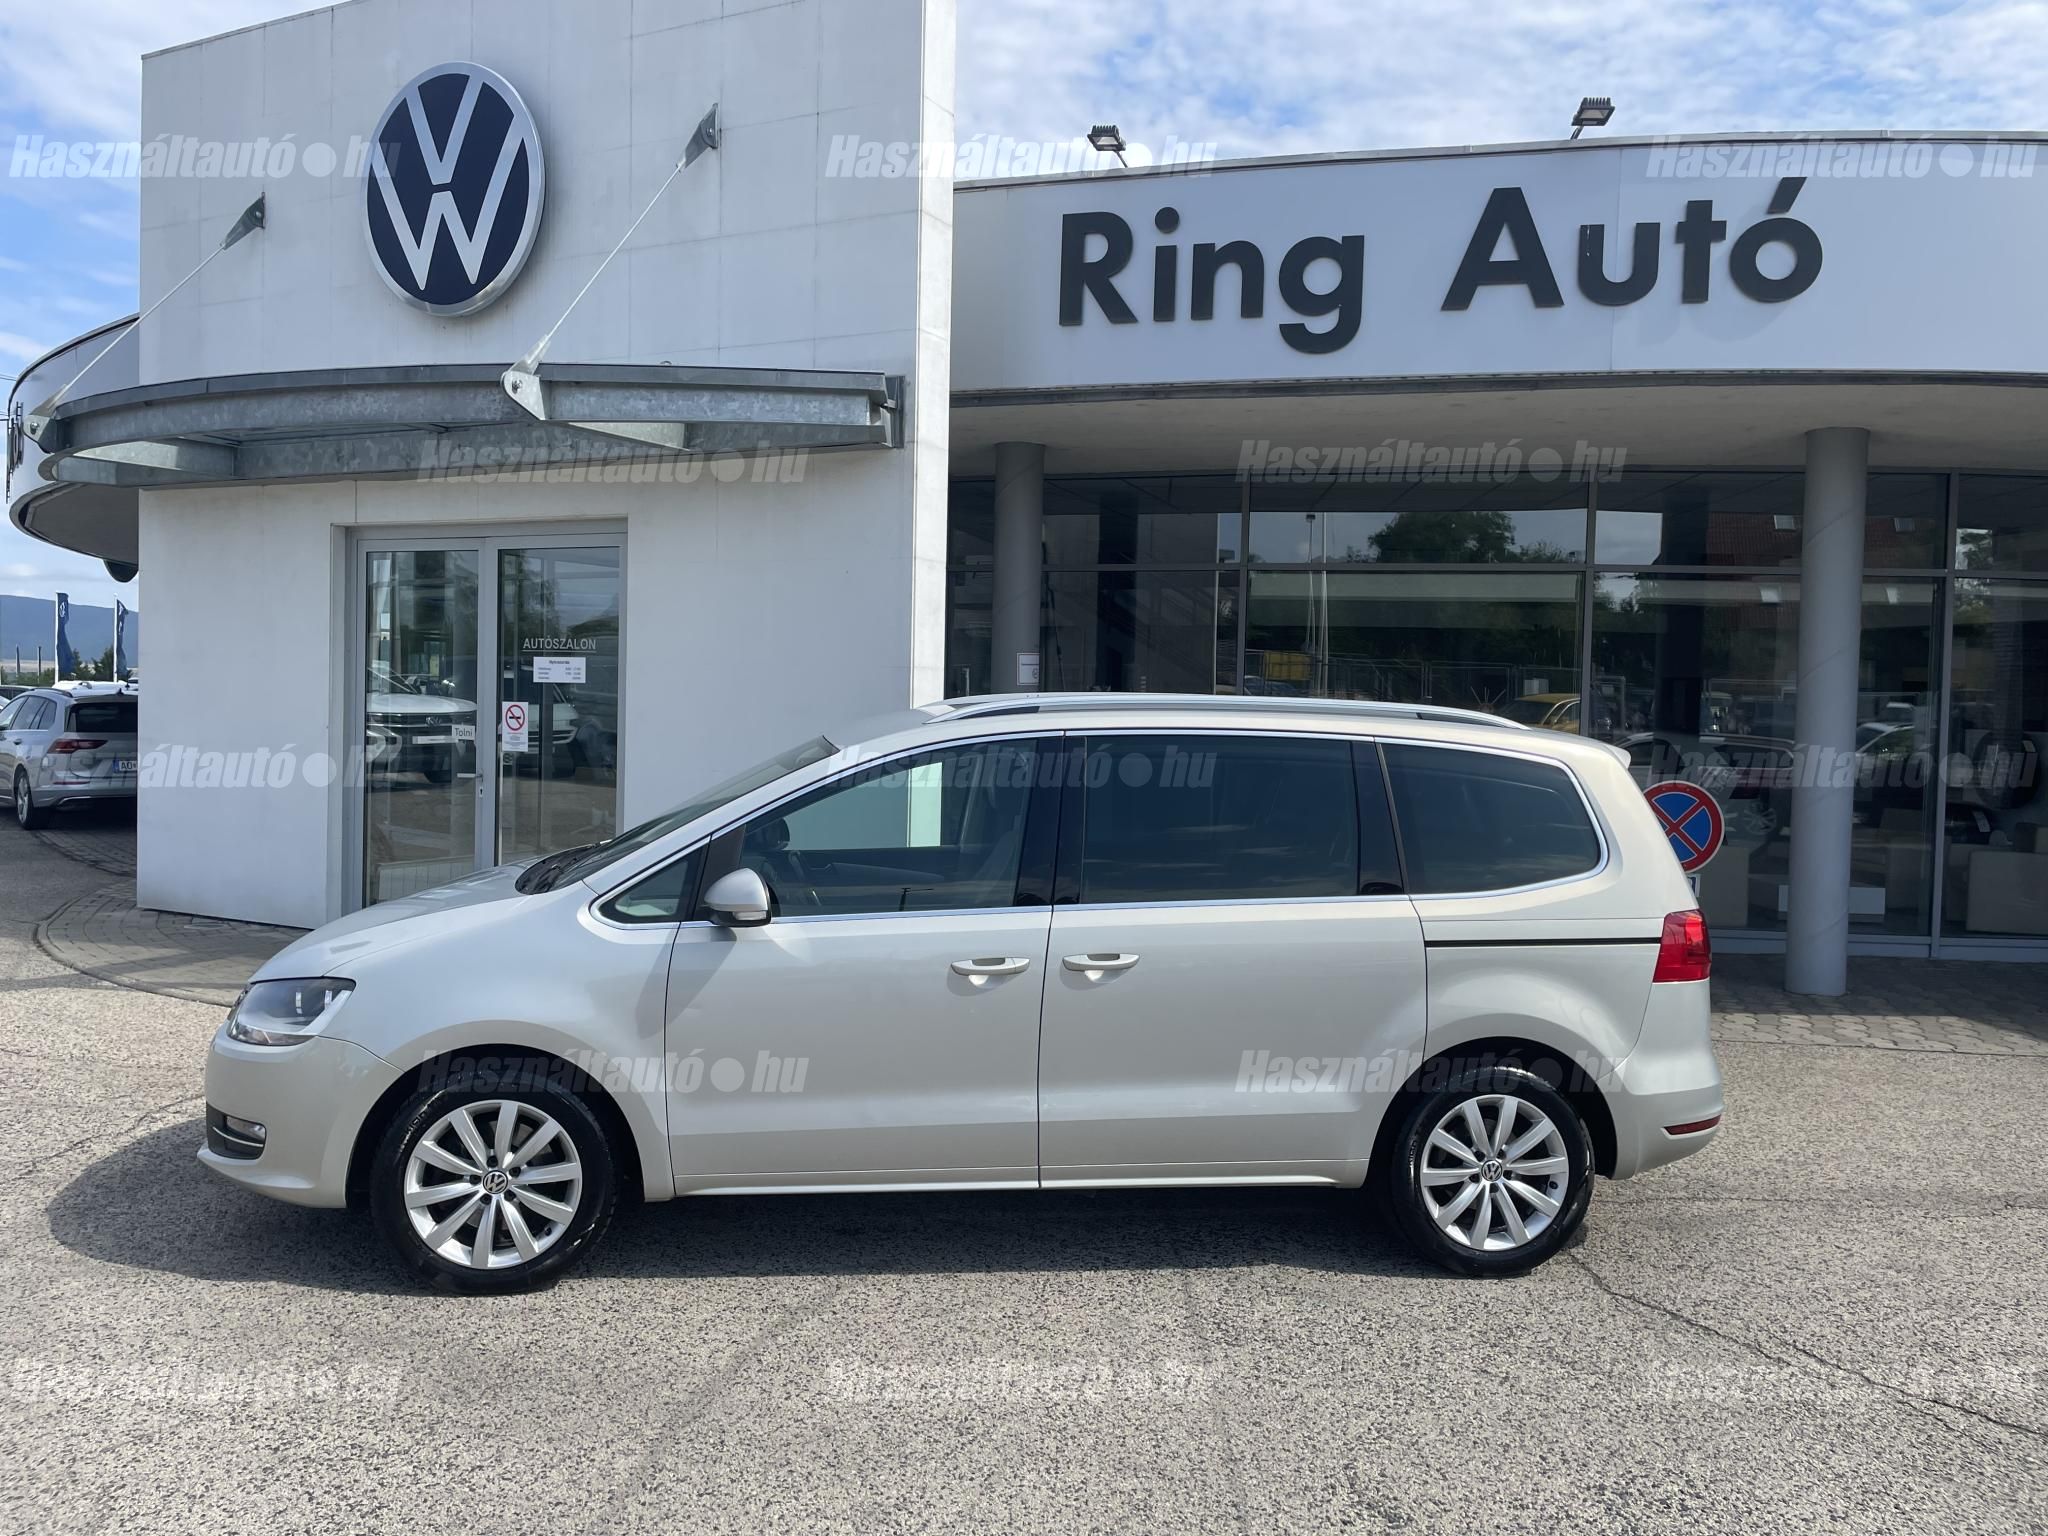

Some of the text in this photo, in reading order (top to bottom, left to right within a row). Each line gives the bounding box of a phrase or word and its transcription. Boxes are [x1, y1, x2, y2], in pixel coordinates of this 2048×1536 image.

[1059, 176, 1824, 354] Ring Autó
[523, 635, 596, 650] AUTÓSZALON
[454, 727, 473, 737] Tolni
